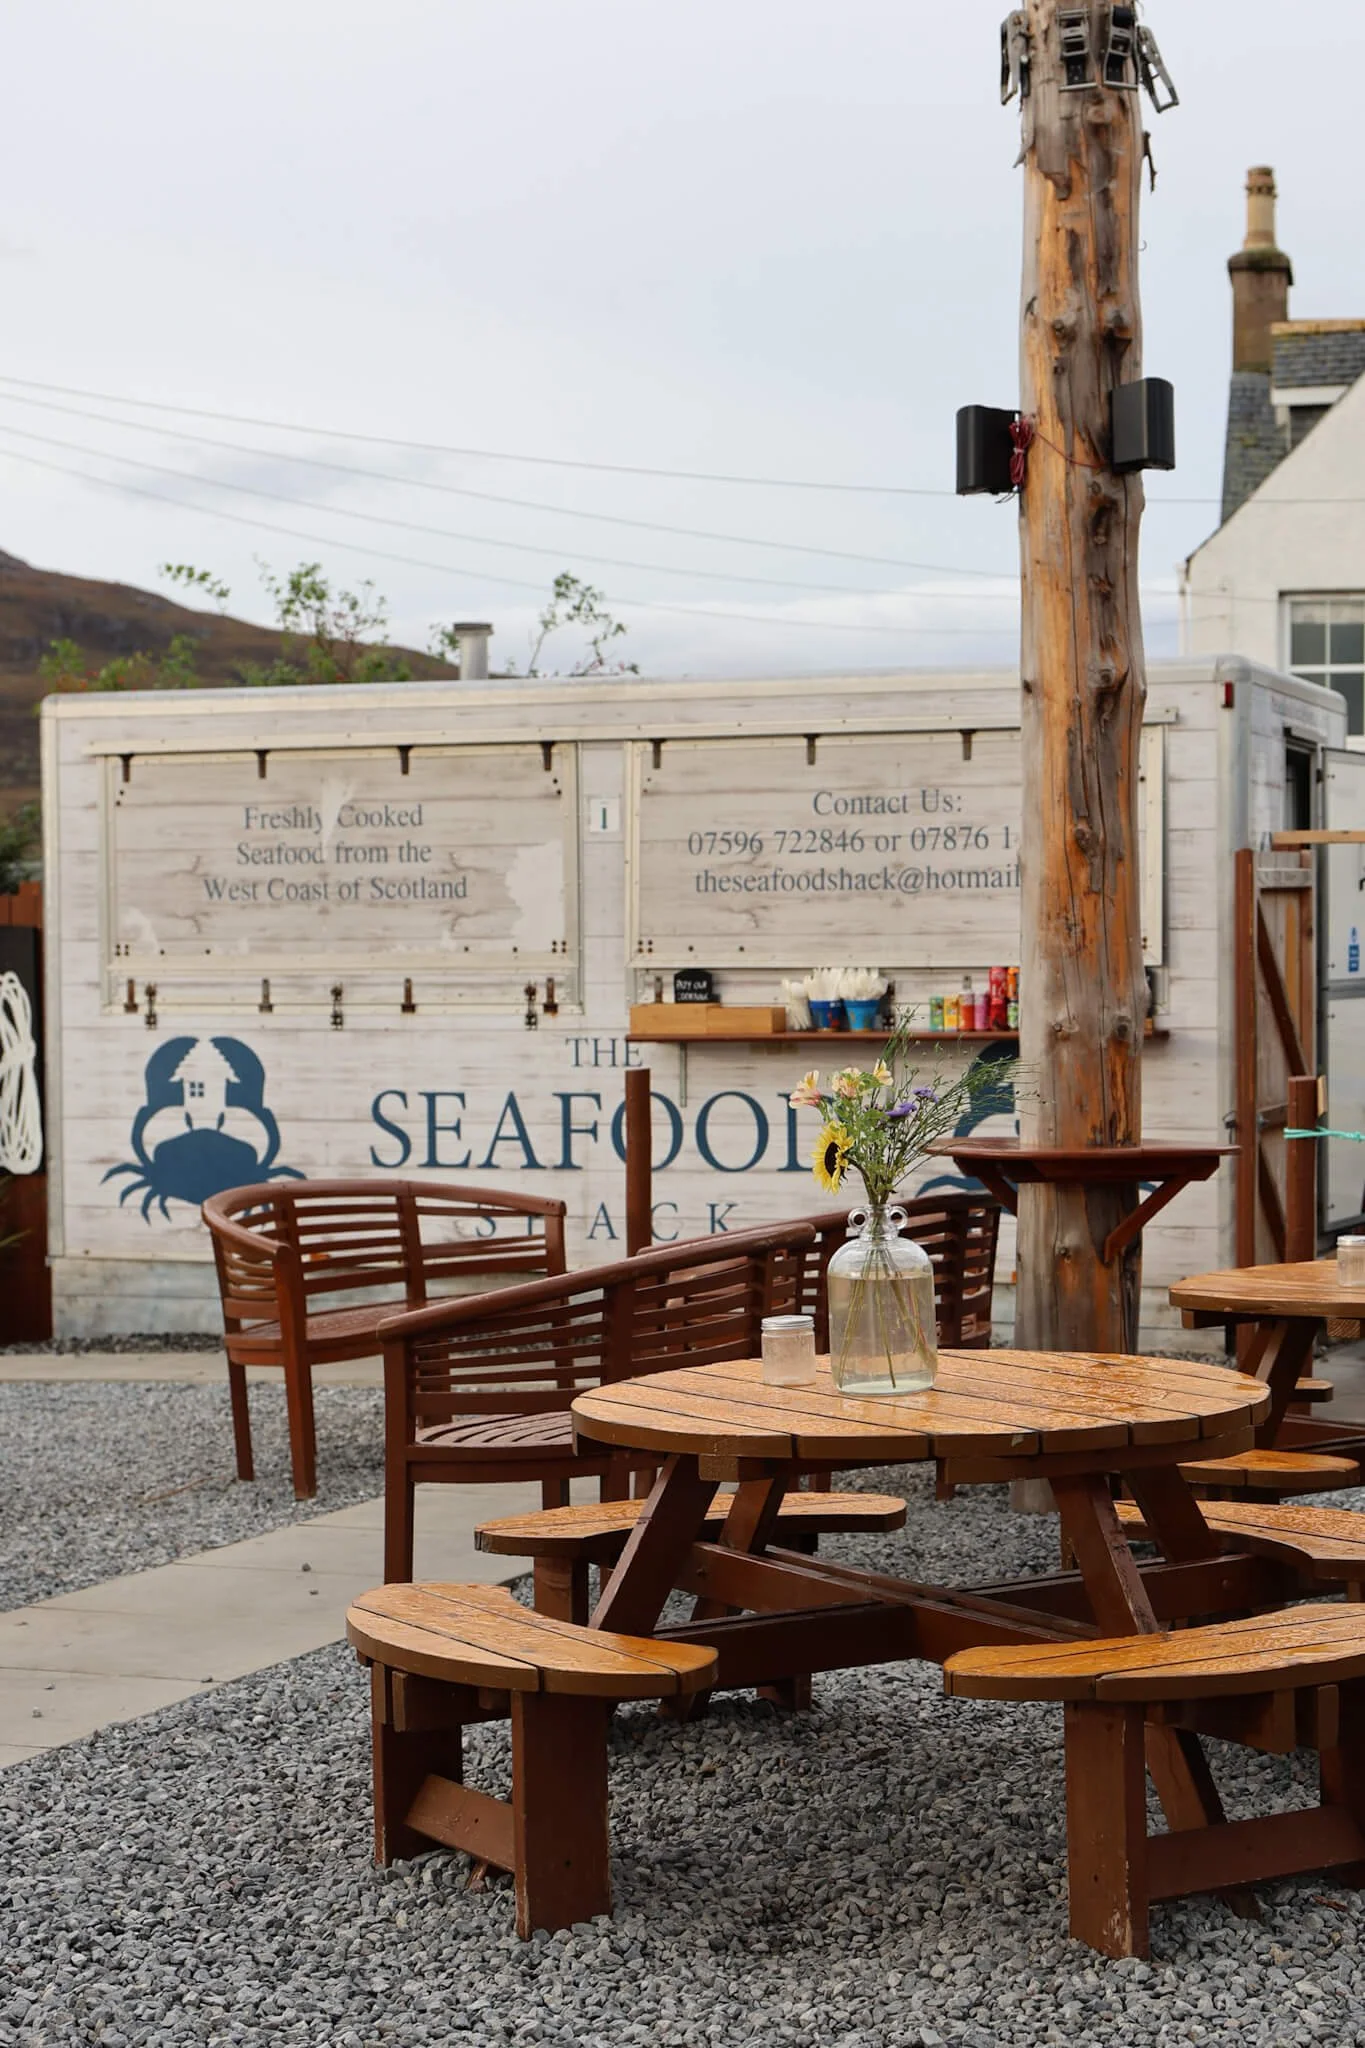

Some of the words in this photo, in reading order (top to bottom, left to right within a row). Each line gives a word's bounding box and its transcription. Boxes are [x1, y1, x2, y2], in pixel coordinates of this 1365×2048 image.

[813, 791, 908, 816] Contact
[921, 788, 963, 813] Us:
[244, 805, 322, 835] Freshly
[337, 803, 423, 829] Cooked
[236, 841, 325, 866] Seafood
[335, 841, 389, 865] from
[398, 839, 432, 864] the
[688, 831, 764, 856] 07596
[774, 828, 865, 854] 722846
[874, 834, 902, 853] or
[911, 825, 990, 851] 07876
[204, 877, 258, 901] West
[267, 876, 329, 902] Coast
[338, 878, 361, 900] of
[370, 875, 468, 901] Scotland
[565, 1037, 643, 1068] THE
